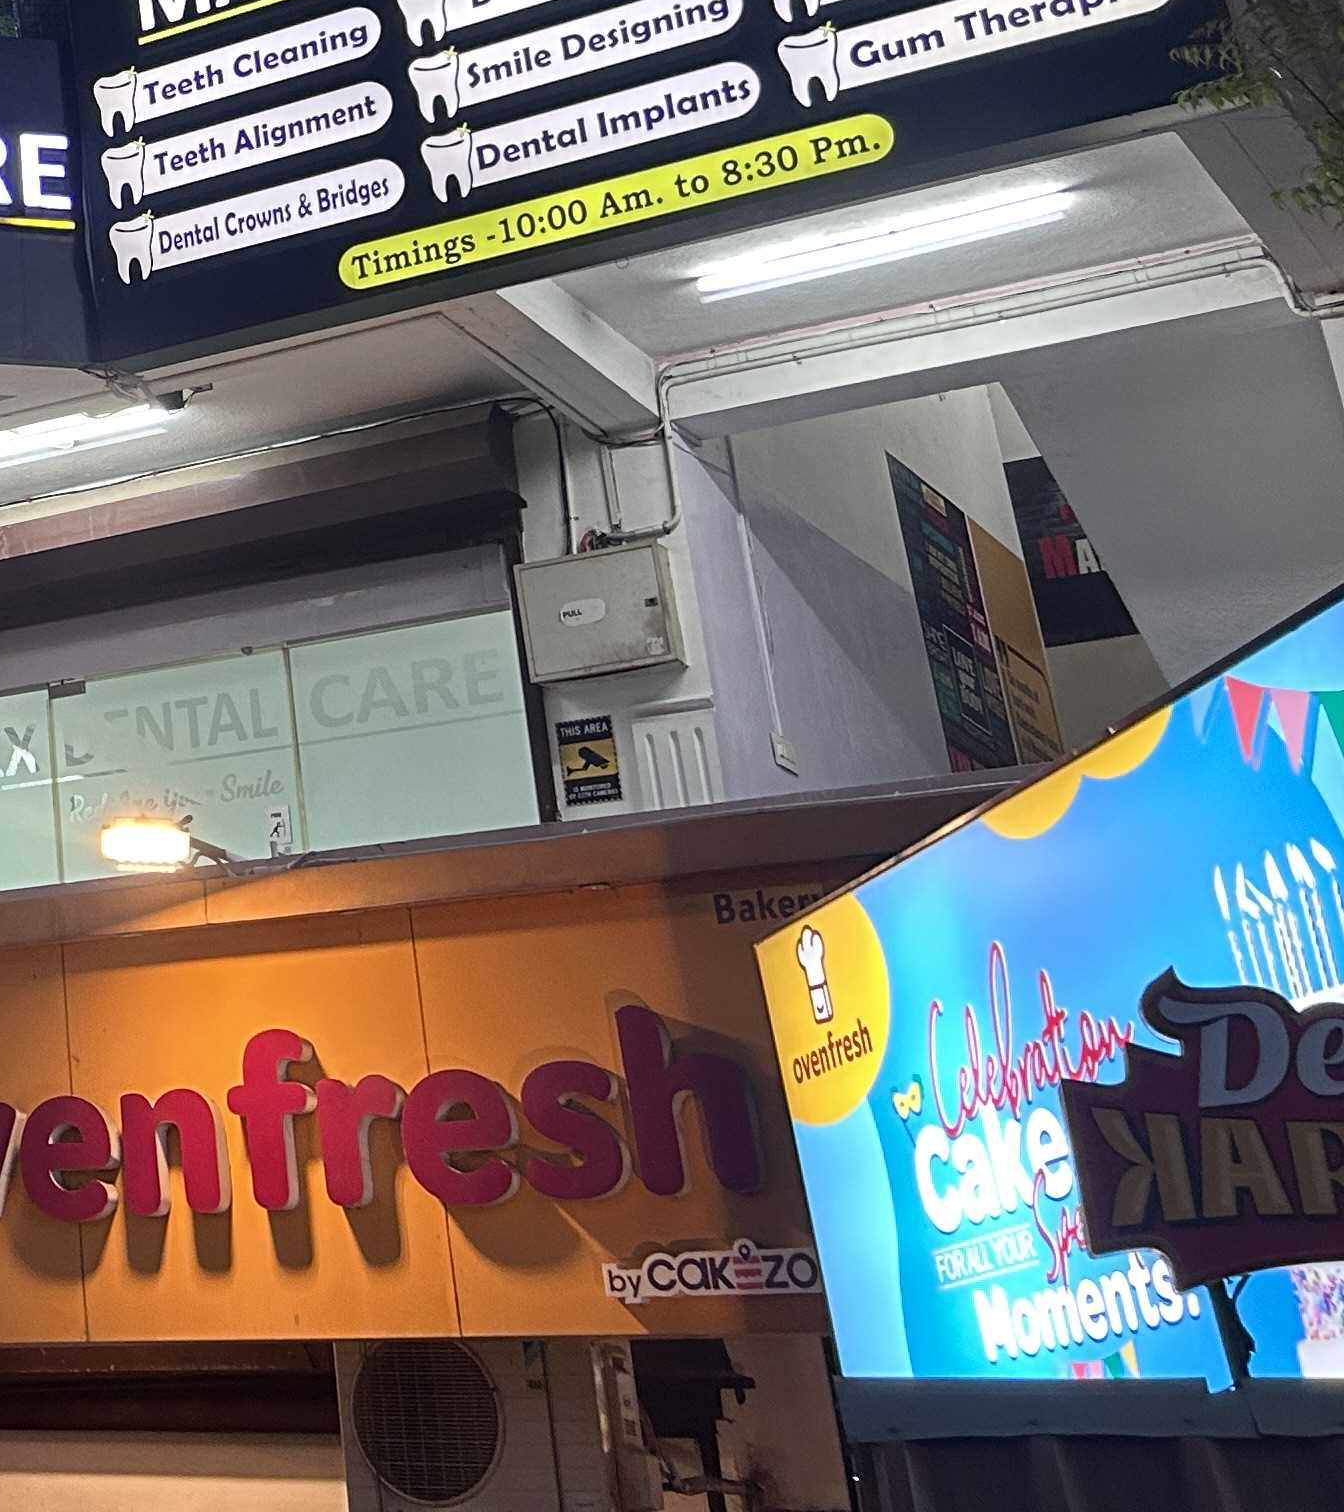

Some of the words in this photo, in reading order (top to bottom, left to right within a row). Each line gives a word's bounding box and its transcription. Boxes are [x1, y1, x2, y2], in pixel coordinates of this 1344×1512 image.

[143, 60, 226, 107] Teeth
[231, 19, 370, 83] Cleaning
[467, 40, 553, 89] Smile
[849, 27, 945, 70] Gum
[153, 126, 228, 177] Teeth
[232, 94, 377, 165] Alignment
[476, 118, 588, 172] Dental
[596, 73, 751, 138] Implants
[158, 212, 220, 256] Dental
[224, 198, 294, 242] Crowns
[297, 192, 314, 218] &
[317, 173, 391, 217] Bridges
[351, 229, 477, 282] Timings
[598, 182, 664, 219] Am.
[674, 165, 710, 198] to
[720, 144, 801, 189] 8:30
[809, 127, 881, 163] Pm.
[562, 609, 583, 619] PULL
[64, 688, 279, 767] NTAL
[312, 647, 506, 728] CARE
[561, 724, 581, 738] THIS
[584, 721, 609, 734] AREA
[220, 769, 284, 803] Smile
[713, 890, 822, 925] Baker
[792, 1018, 874, 1085] ovenfresh
[929, 940, 1135, 1136] Celebration
[914, 1105, 1073, 1233] Cake
[609, 1268, 642, 1299] by
[646, 1244, 818, 1291] cakezo
[935, 1251, 965, 1282] FOR
[965, 1243, 993, 1274] ALL
[993, 1231, 1037, 1269] YOUR
[973, 1252, 1201, 1362] Moments.
